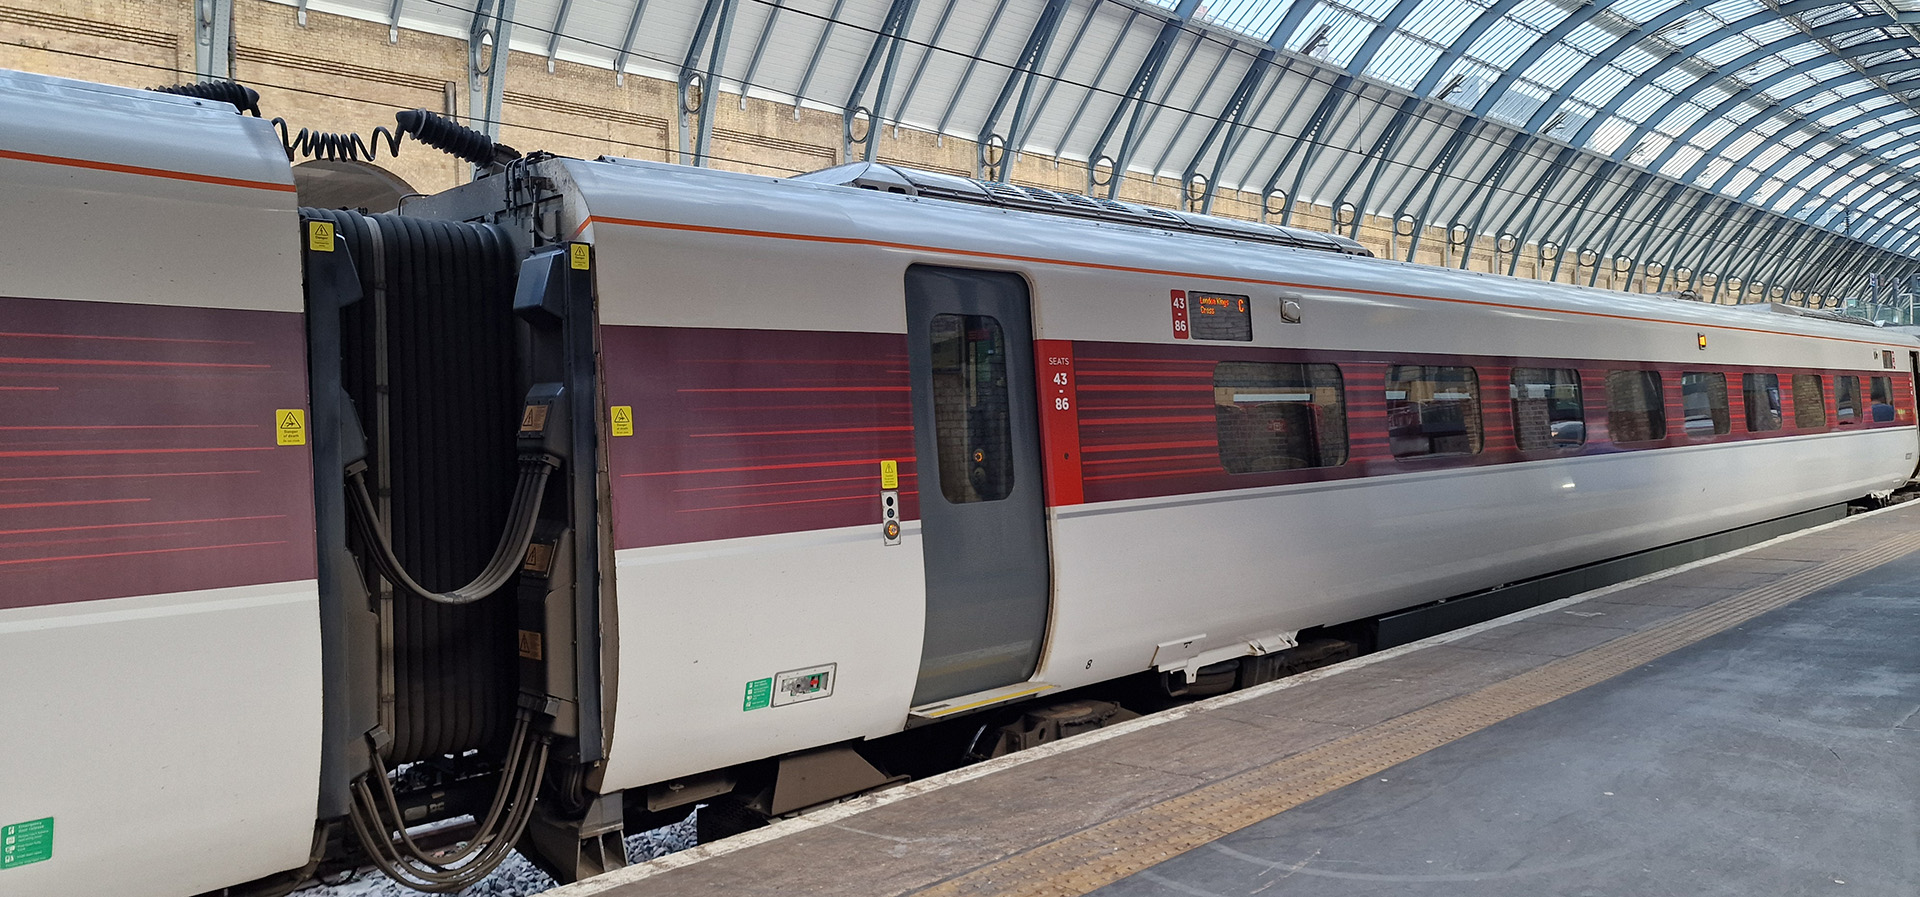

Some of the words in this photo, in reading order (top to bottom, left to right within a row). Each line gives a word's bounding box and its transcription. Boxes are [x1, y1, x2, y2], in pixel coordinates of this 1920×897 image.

[1173, 297, 1185, 309] 43
[1199, 296, 1216, 305] London
[1216, 297, 1230, 308] Kings
[1237, 299, 1245, 313] C
[1200, 305, 1215, 315] Cross
[1174, 320, 1187, 332] 86
[1048, 357, 1070, 366] SEATS
[1053, 372, 1068, 385] 43
[1055, 397, 1070, 411] 86
[1085, 659, 1093, 670] 8
